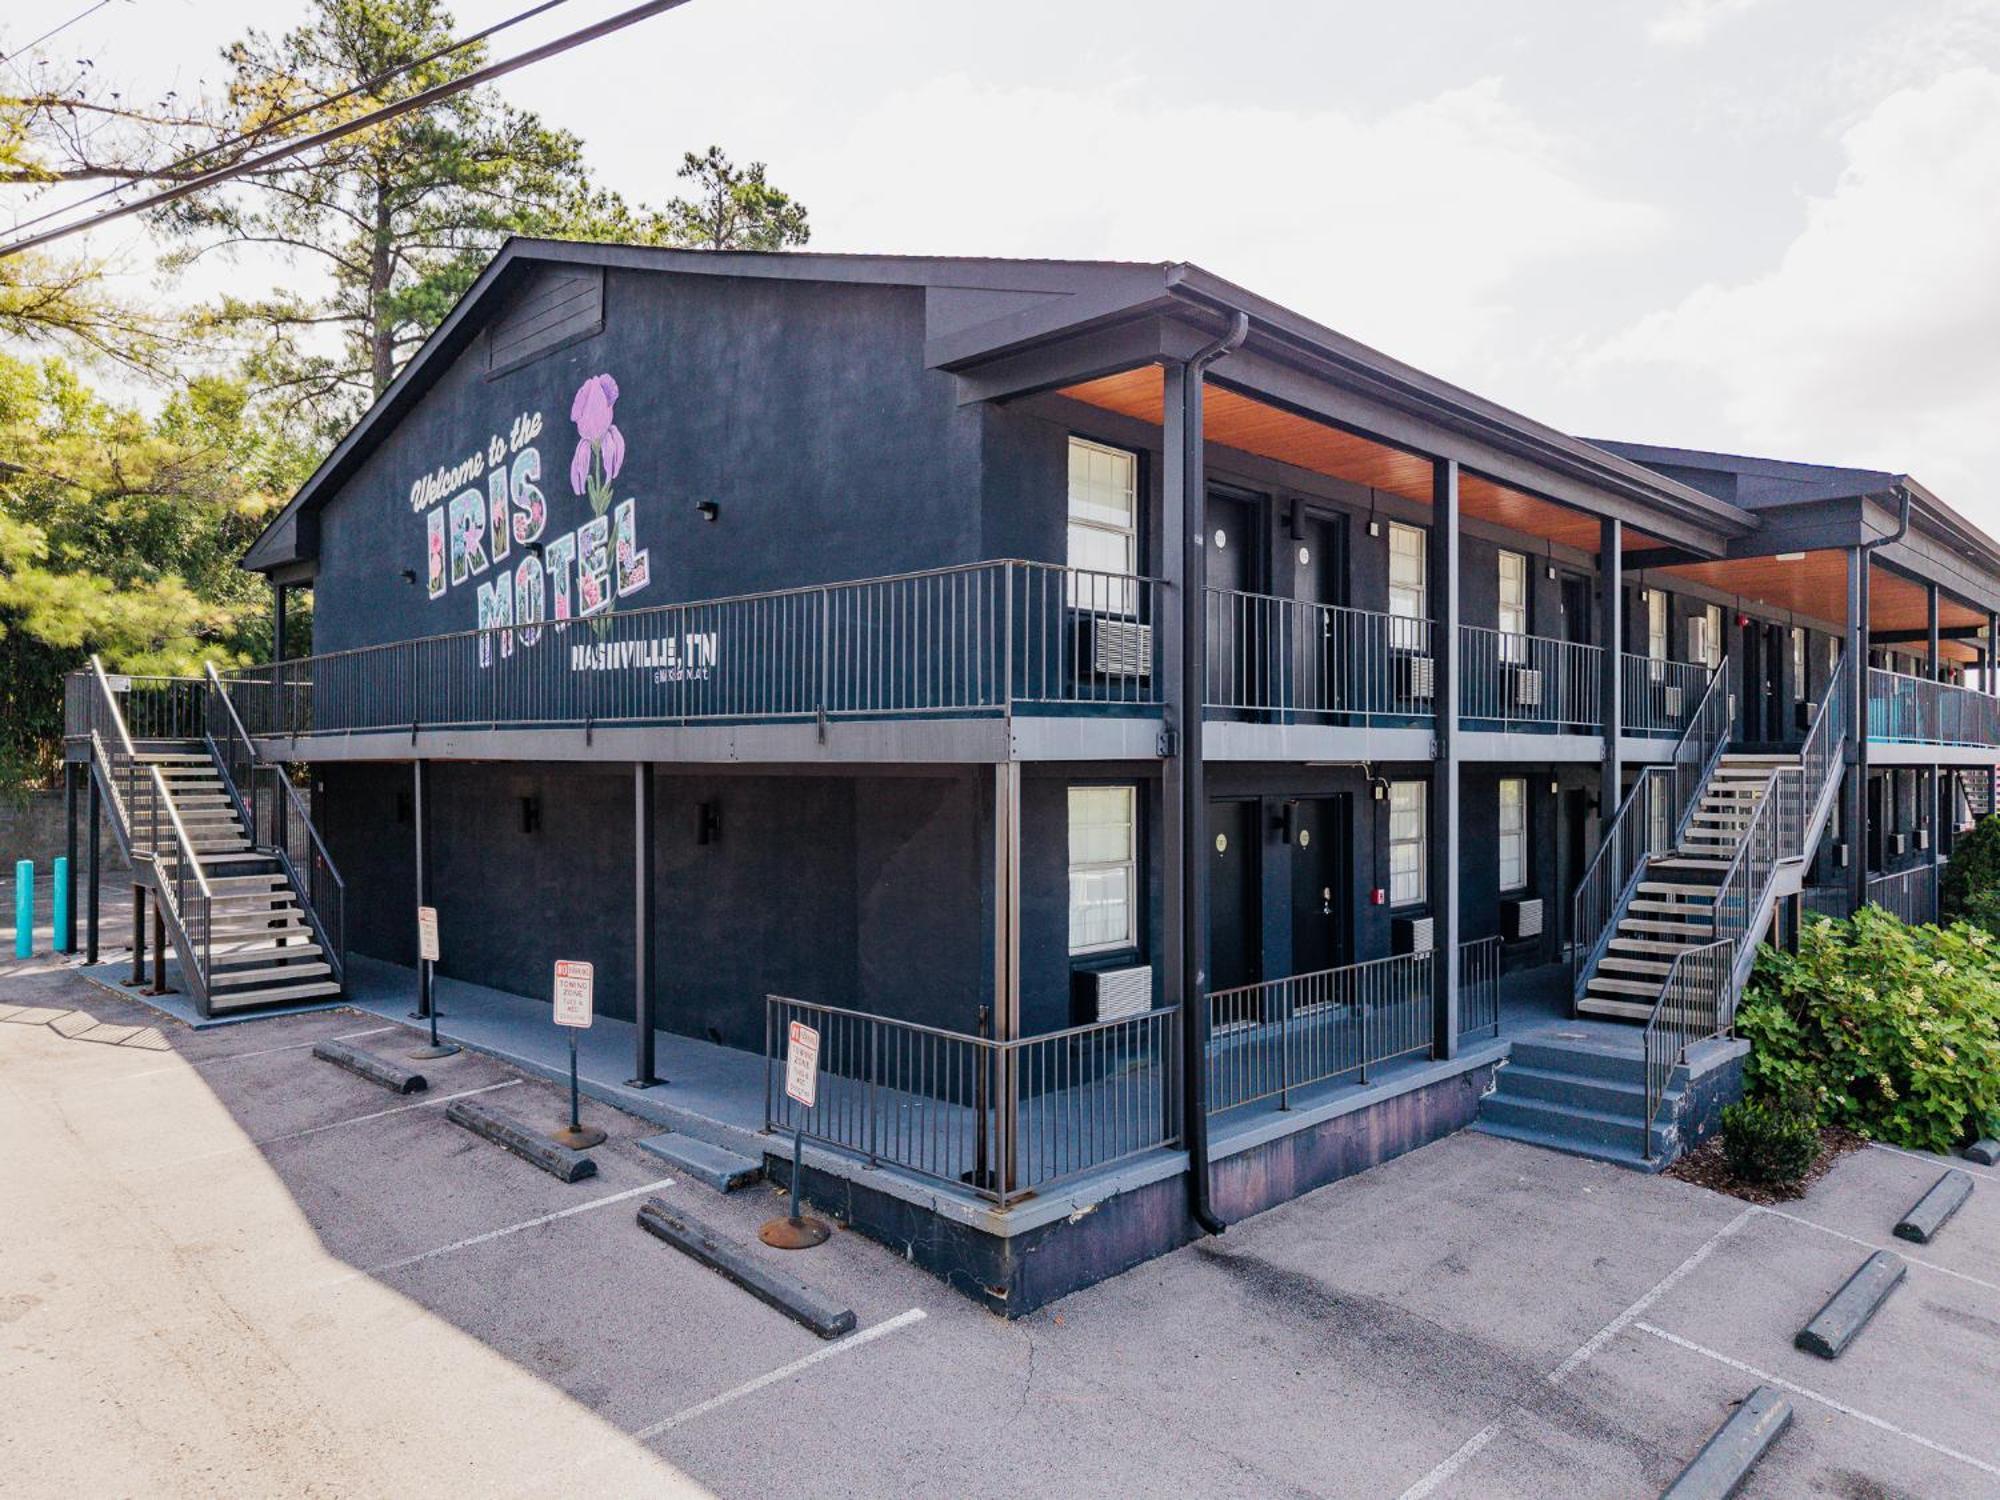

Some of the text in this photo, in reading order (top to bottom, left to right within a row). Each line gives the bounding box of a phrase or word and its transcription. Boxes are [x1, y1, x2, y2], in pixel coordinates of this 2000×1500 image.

[410, 411, 543, 513] Welcome to the
[427, 447, 547, 600] IRIS
[477, 498, 650, 669] MOTEL
[686, 632, 717, 667] TN
